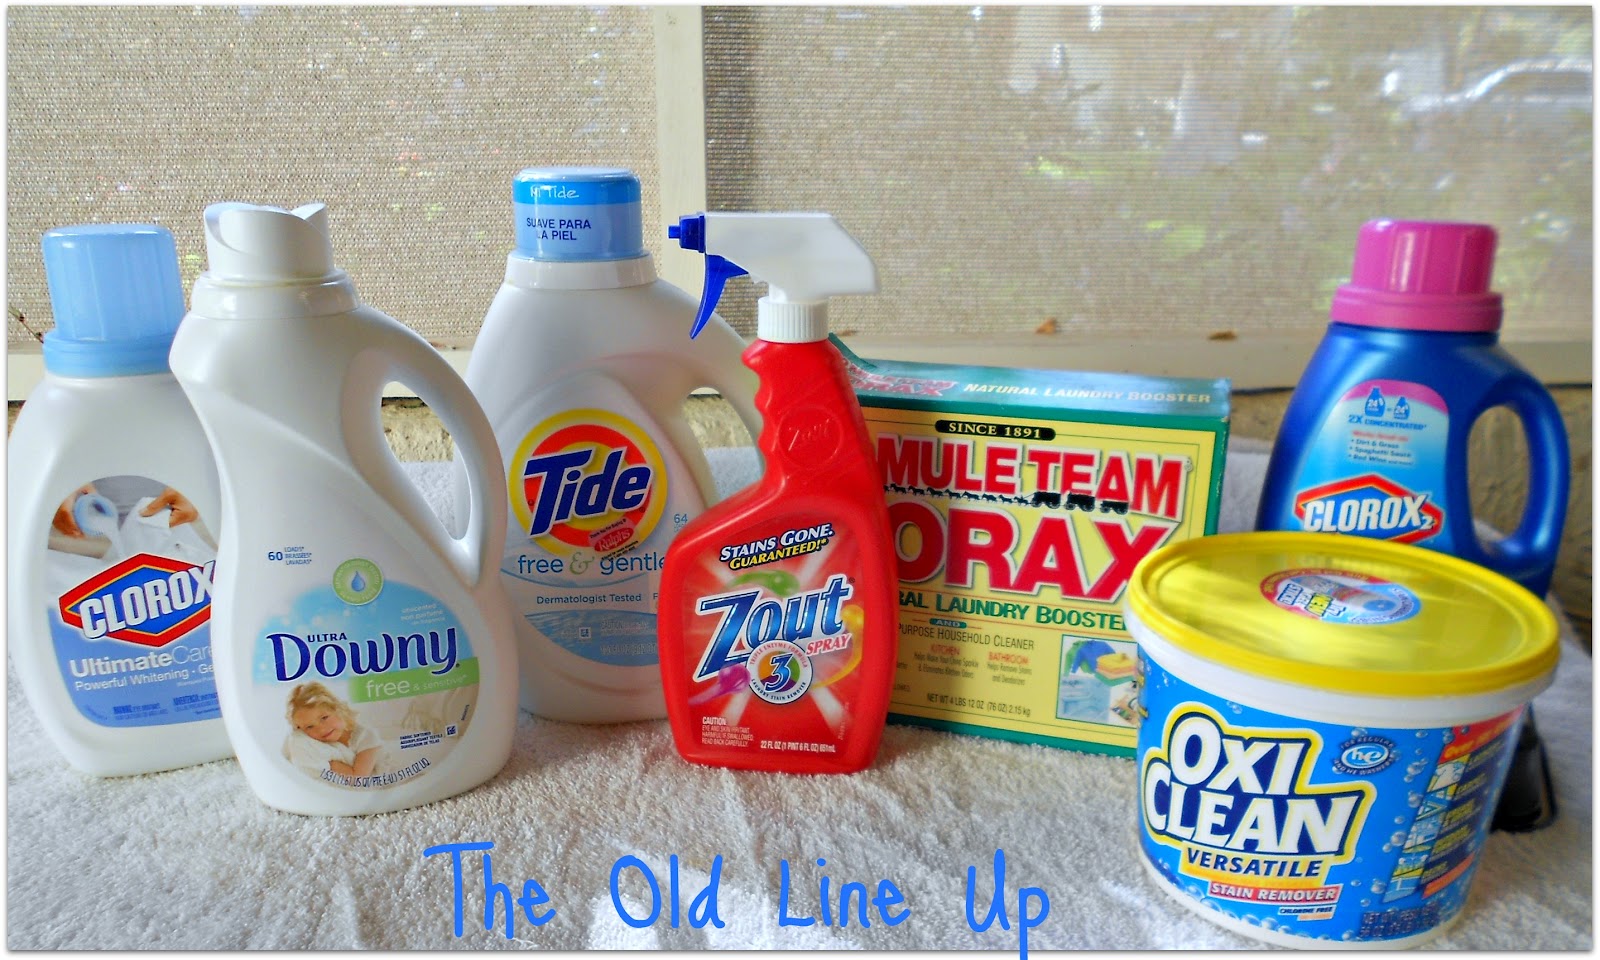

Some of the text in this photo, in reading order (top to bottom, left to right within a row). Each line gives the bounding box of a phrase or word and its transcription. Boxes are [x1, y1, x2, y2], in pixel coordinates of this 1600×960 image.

[543, 185, 580, 198] Tide
[527, 217, 592, 229] SUAVE PARA
[552, 230, 577, 241] PIEL
[963, 383, 1211, 404] NATURAL LAUNDRY BOOSTER
[1348, 414, 1363, 424] 2X
[948, 421, 1042, 440] SINCE 1891
[876, 434, 1187, 522] MULE TEAM
[524, 449, 652, 538] Tide
[674, 514, 688, 524] 64
[721, 523, 834, 561] STAINS GONE.
[268, 551, 283, 561] 60
[518, 552, 665, 576] free & gentle
[79, 559, 216, 640] CLOROX
[536, 595, 606, 605] Dermatologist
[609, 593, 642, 602] Tested
[936, 593, 1030, 621] LAUNDRY
[1036, 605, 1127, 631] BOOSTE
[694, 574, 854, 682] Zout
[935, 618, 962, 629] AND
[307, 632, 347, 642] ULTRA
[806, 634, 852, 656] SPRAY
[937, 627, 991, 645] HOUSEHOLD
[994, 634, 1035, 651] CLEANER
[265, 627, 456, 682] Downy
[988, 651, 1030, 665] BATHROOM
[75, 676, 127, 691] Powerful
[130, 668, 190, 685] Whitening
[764, 653, 794, 692] 3
[366, 680, 410, 698] free
[927, 693, 938, 704] NET
[939, 695, 948, 704] WT
[955, 697, 967, 707] LBS
[968, 699, 975, 708] 12
[976, 700, 984, 710] OZ
[760, 740, 767, 749] 22
[768, 741, 774, 749] FL
[774, 741, 781, 750] OZ
[1169, 716, 1304, 795] OXI
[1351, 748, 1383, 764] he
[1146, 763, 1361, 855] CLEAN
[1187, 847, 1323, 877] VERSATILE
[1211, 883, 1337, 902] STAIN REMOVER
